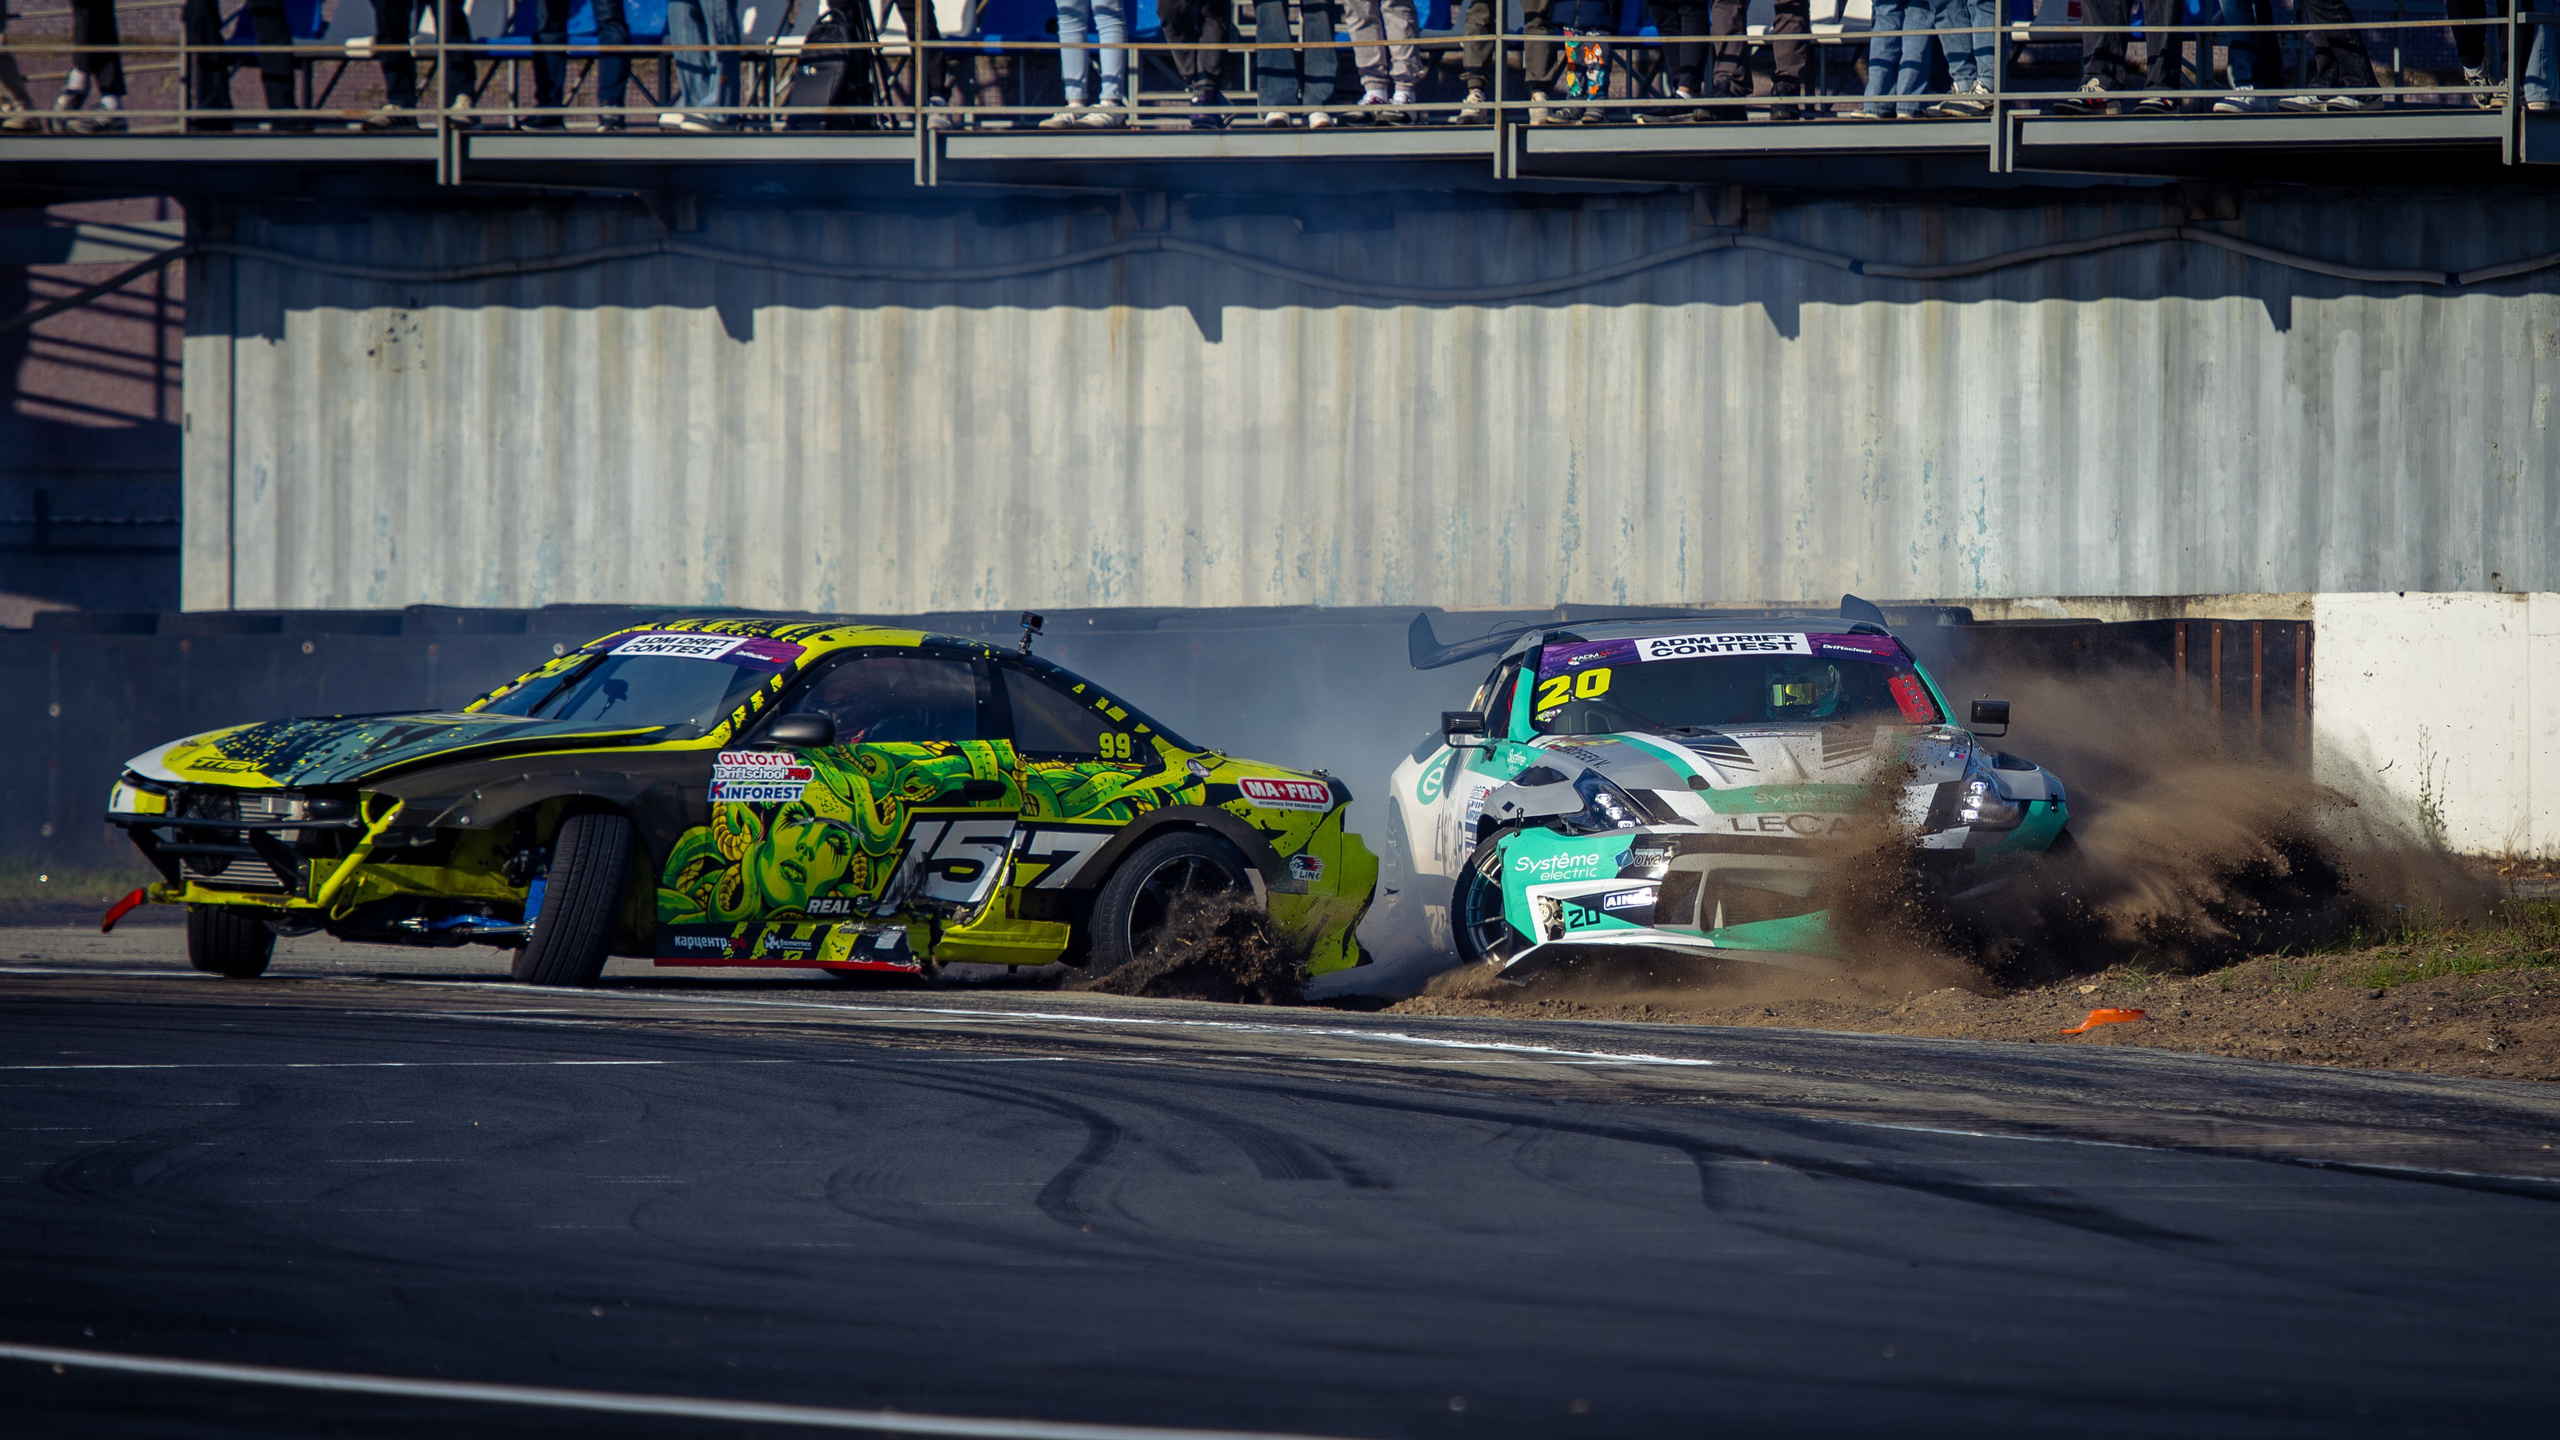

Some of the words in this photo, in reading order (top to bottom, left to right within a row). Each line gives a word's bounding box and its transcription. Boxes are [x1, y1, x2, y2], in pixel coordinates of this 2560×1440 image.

[638, 637, 677, 645] ADM
[680, 638, 737, 648] DRIFT
[1650, 636, 1711, 648] ADM
[1717, 634, 1795, 644] DRIFT
[621, 644, 720, 655] CONTEST
[1651, 642, 1797, 658] CONTEST
[1537, 667, 1612, 712] 20
[1099, 732, 1131, 758] 99
[720, 752, 794, 765] auto.ru
[716, 767, 812, 780] Driftschool.PRO
[709, 782, 803, 799] KINFOREST
[1540, 866, 1598, 881] electric
[806, 899, 851, 914] REAL
[1569, 907, 1600, 929] 20
